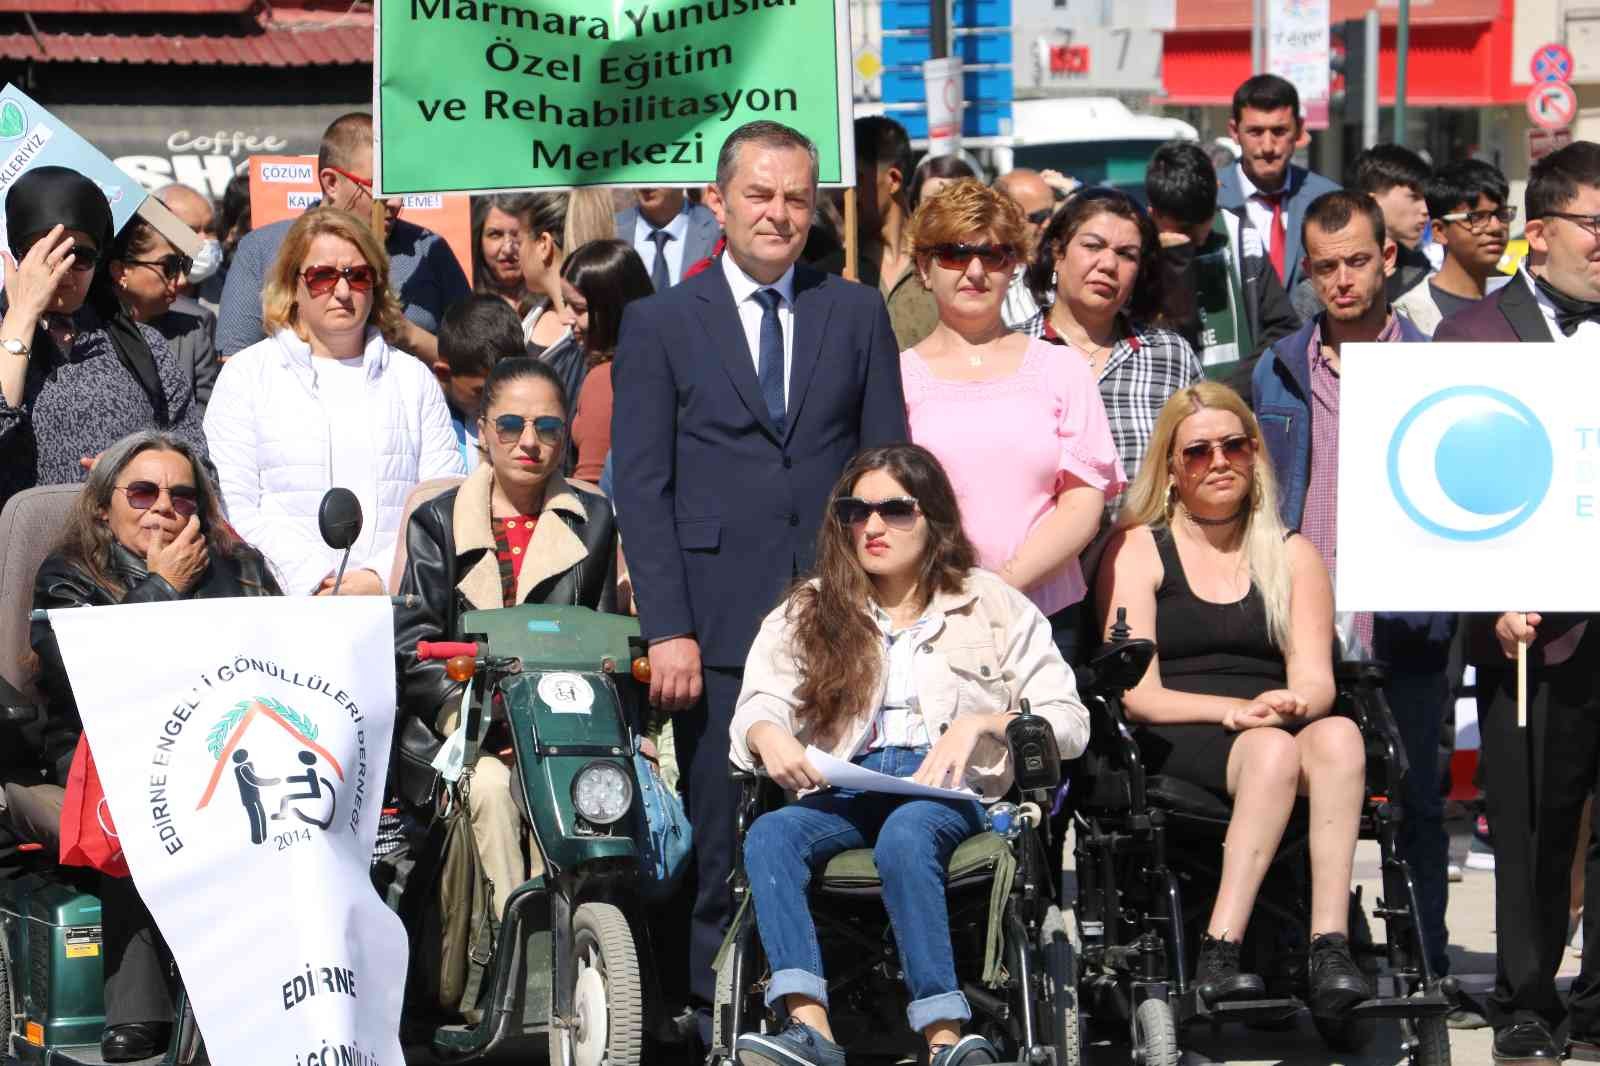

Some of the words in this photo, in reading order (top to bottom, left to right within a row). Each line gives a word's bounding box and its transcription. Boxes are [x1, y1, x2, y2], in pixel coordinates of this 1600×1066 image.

[411, 0, 609, 41] Marmara
[625, 0, 796, 38] Yunus
[486, 36, 581, 83] Özel
[600, 43, 733, 90] Eğitim
[418, 98, 466, 122] ve
[485, 88, 798, 128] Rehabilitasyon
[167, 130, 288, 156] Coffee
[533, 132, 704, 171] Merkezi
[262, 166, 312, 181] ÇÖZÜM
[1574, 426, 1600, 450] T
[217, 653, 366, 724] GÖNÜLLÜLERİ
[152, 673, 214, 768] ENGELİ
[149, 774, 185, 856] EDİRNE
[273, 828, 313, 851] 2014
[282, 962, 358, 1011] EDİRNE
